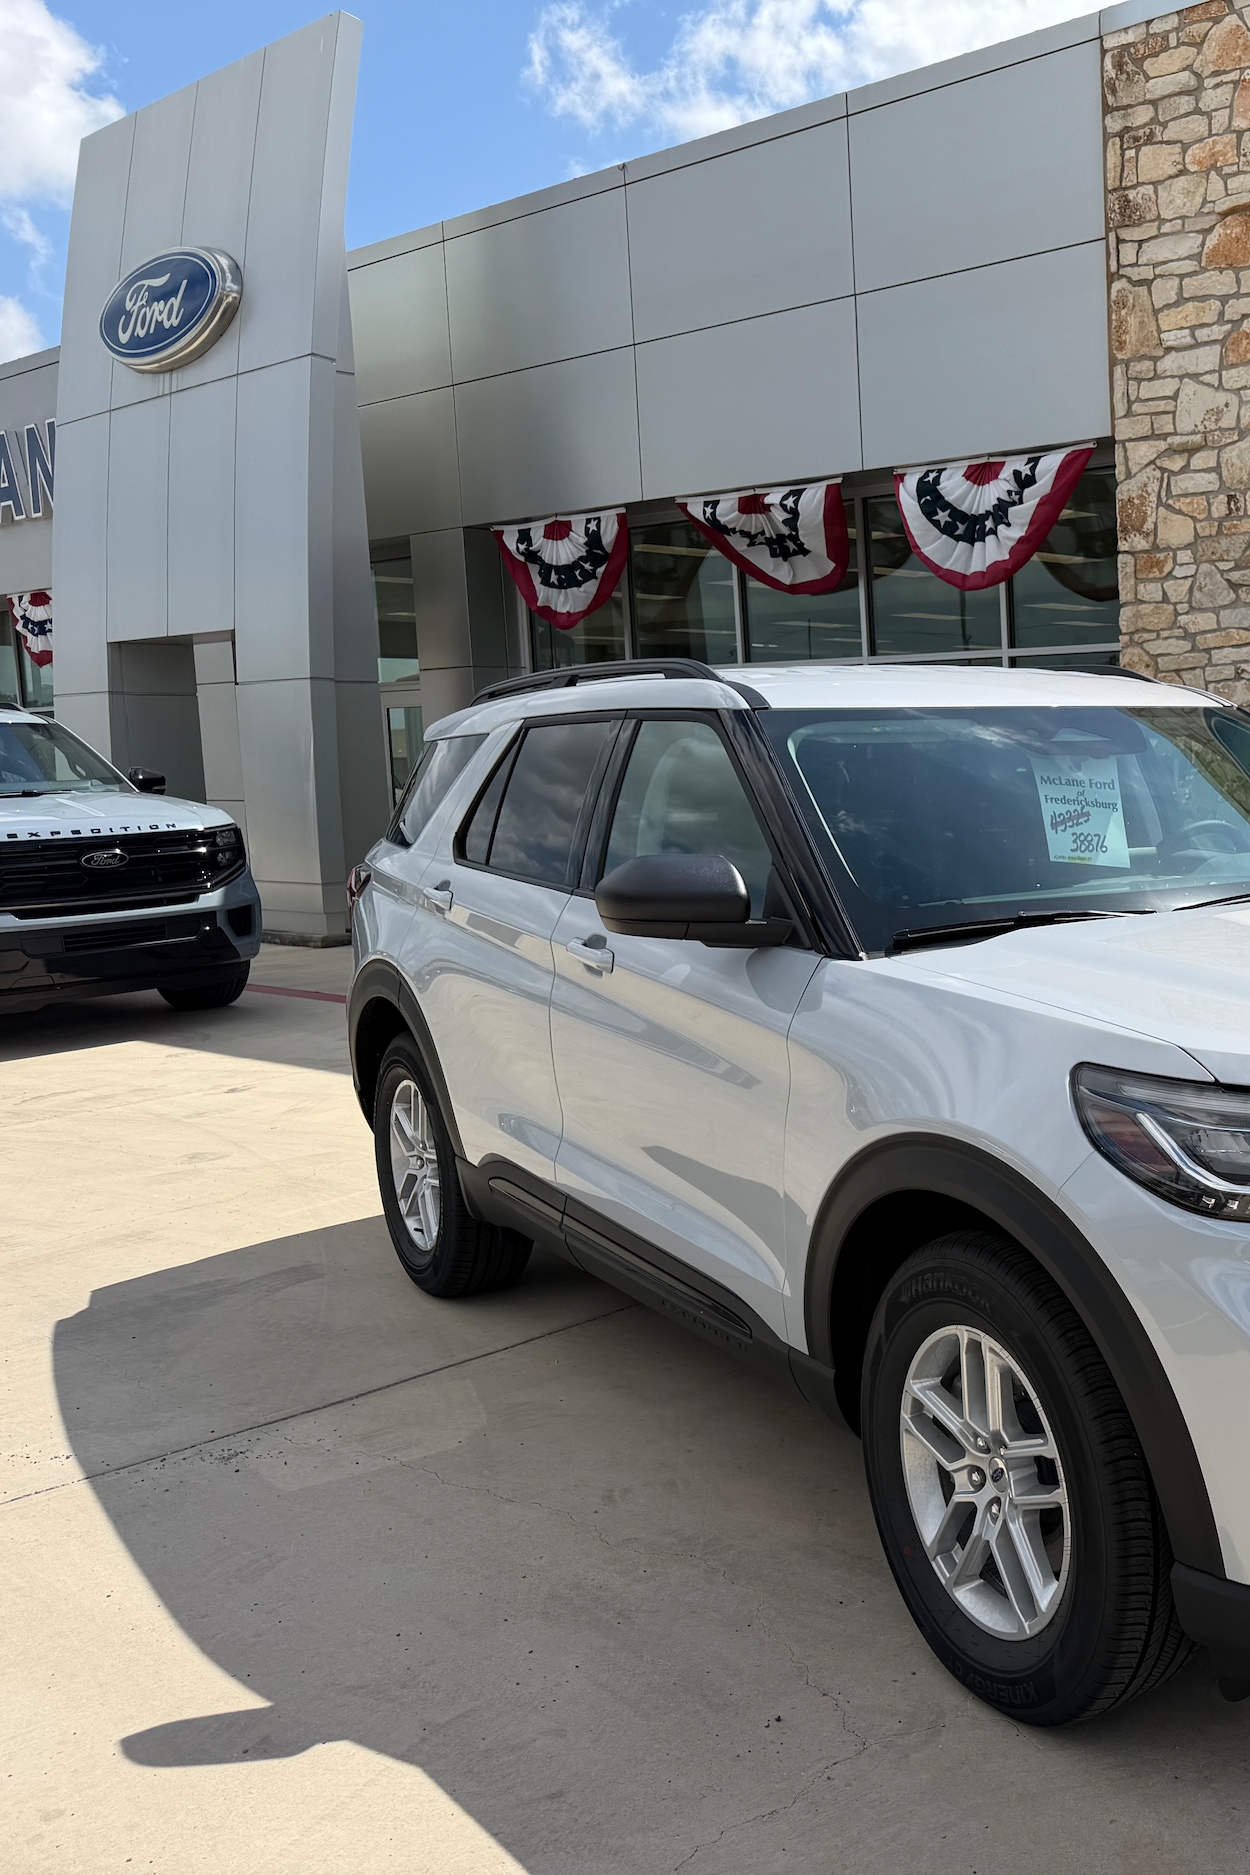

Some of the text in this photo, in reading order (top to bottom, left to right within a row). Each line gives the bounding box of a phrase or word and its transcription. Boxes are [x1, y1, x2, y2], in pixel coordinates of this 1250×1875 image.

[118, 273, 188, 344] Ford
[1040, 775, 1115, 790] McLane Ford
[1077, 790, 1085, 798] of
[1044, 794, 1118, 812] Fredericksburg
[6, 823, 177, 839] EXPEDITION
[1070, 832, 1108, 853] 38876
[91, 854, 120, 866] Ford
